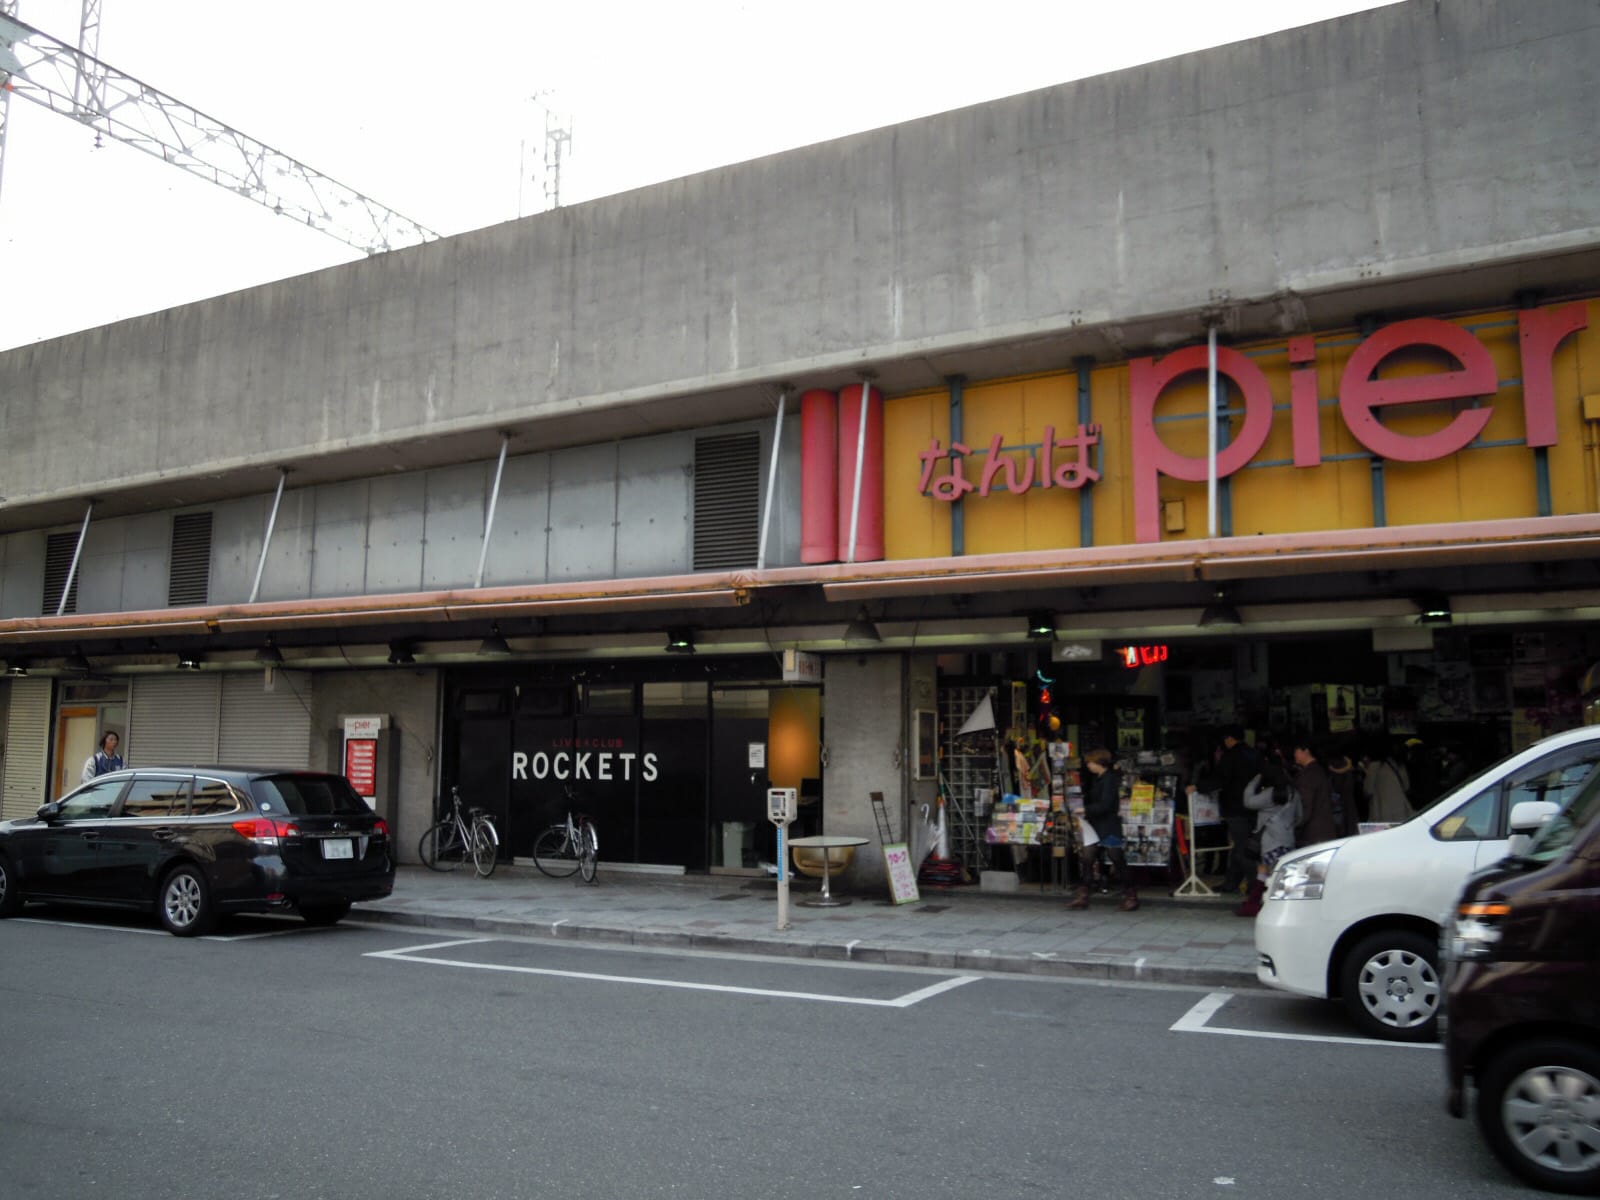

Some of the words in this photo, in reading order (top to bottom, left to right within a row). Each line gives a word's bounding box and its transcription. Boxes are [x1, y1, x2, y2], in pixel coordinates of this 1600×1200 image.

[918, 424, 1102, 501] なんば
[1129, 302, 1588, 543] pier
[512, 752, 658, 781] ROCKETS
